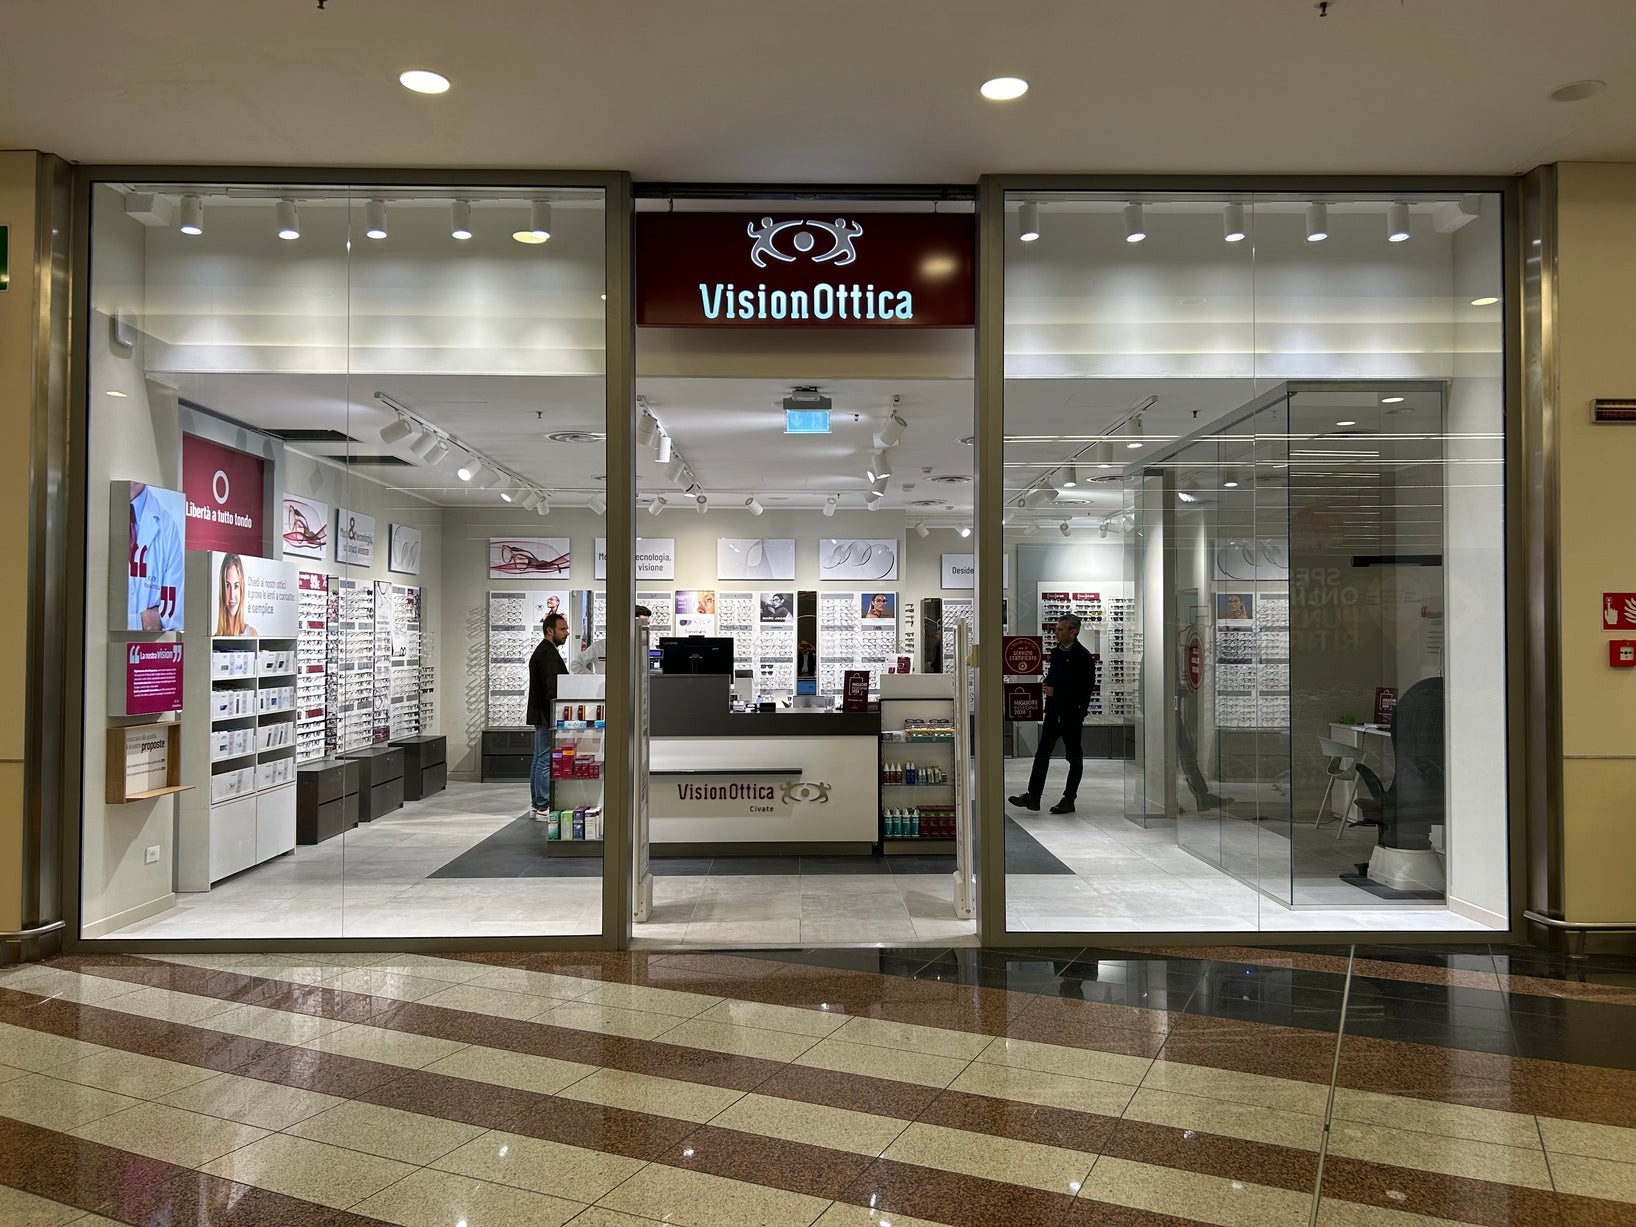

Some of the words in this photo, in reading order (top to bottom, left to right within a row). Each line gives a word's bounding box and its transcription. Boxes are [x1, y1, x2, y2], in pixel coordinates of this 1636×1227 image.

[699, 283, 913, 320] VisionOttica
[185, 501, 211, 520] Libertà
[212, 510, 217, 522] a
[218, 509, 234, 525] tutto
[234, 512, 252, 528] tondo
[635, 553, 672, 563] ecnologia,
[638, 562, 664, 572] visione
[252, 603, 274, 616] semplice
[141, 739, 165, 753] proposte
[677, 783, 774, 800] VisionOttica
